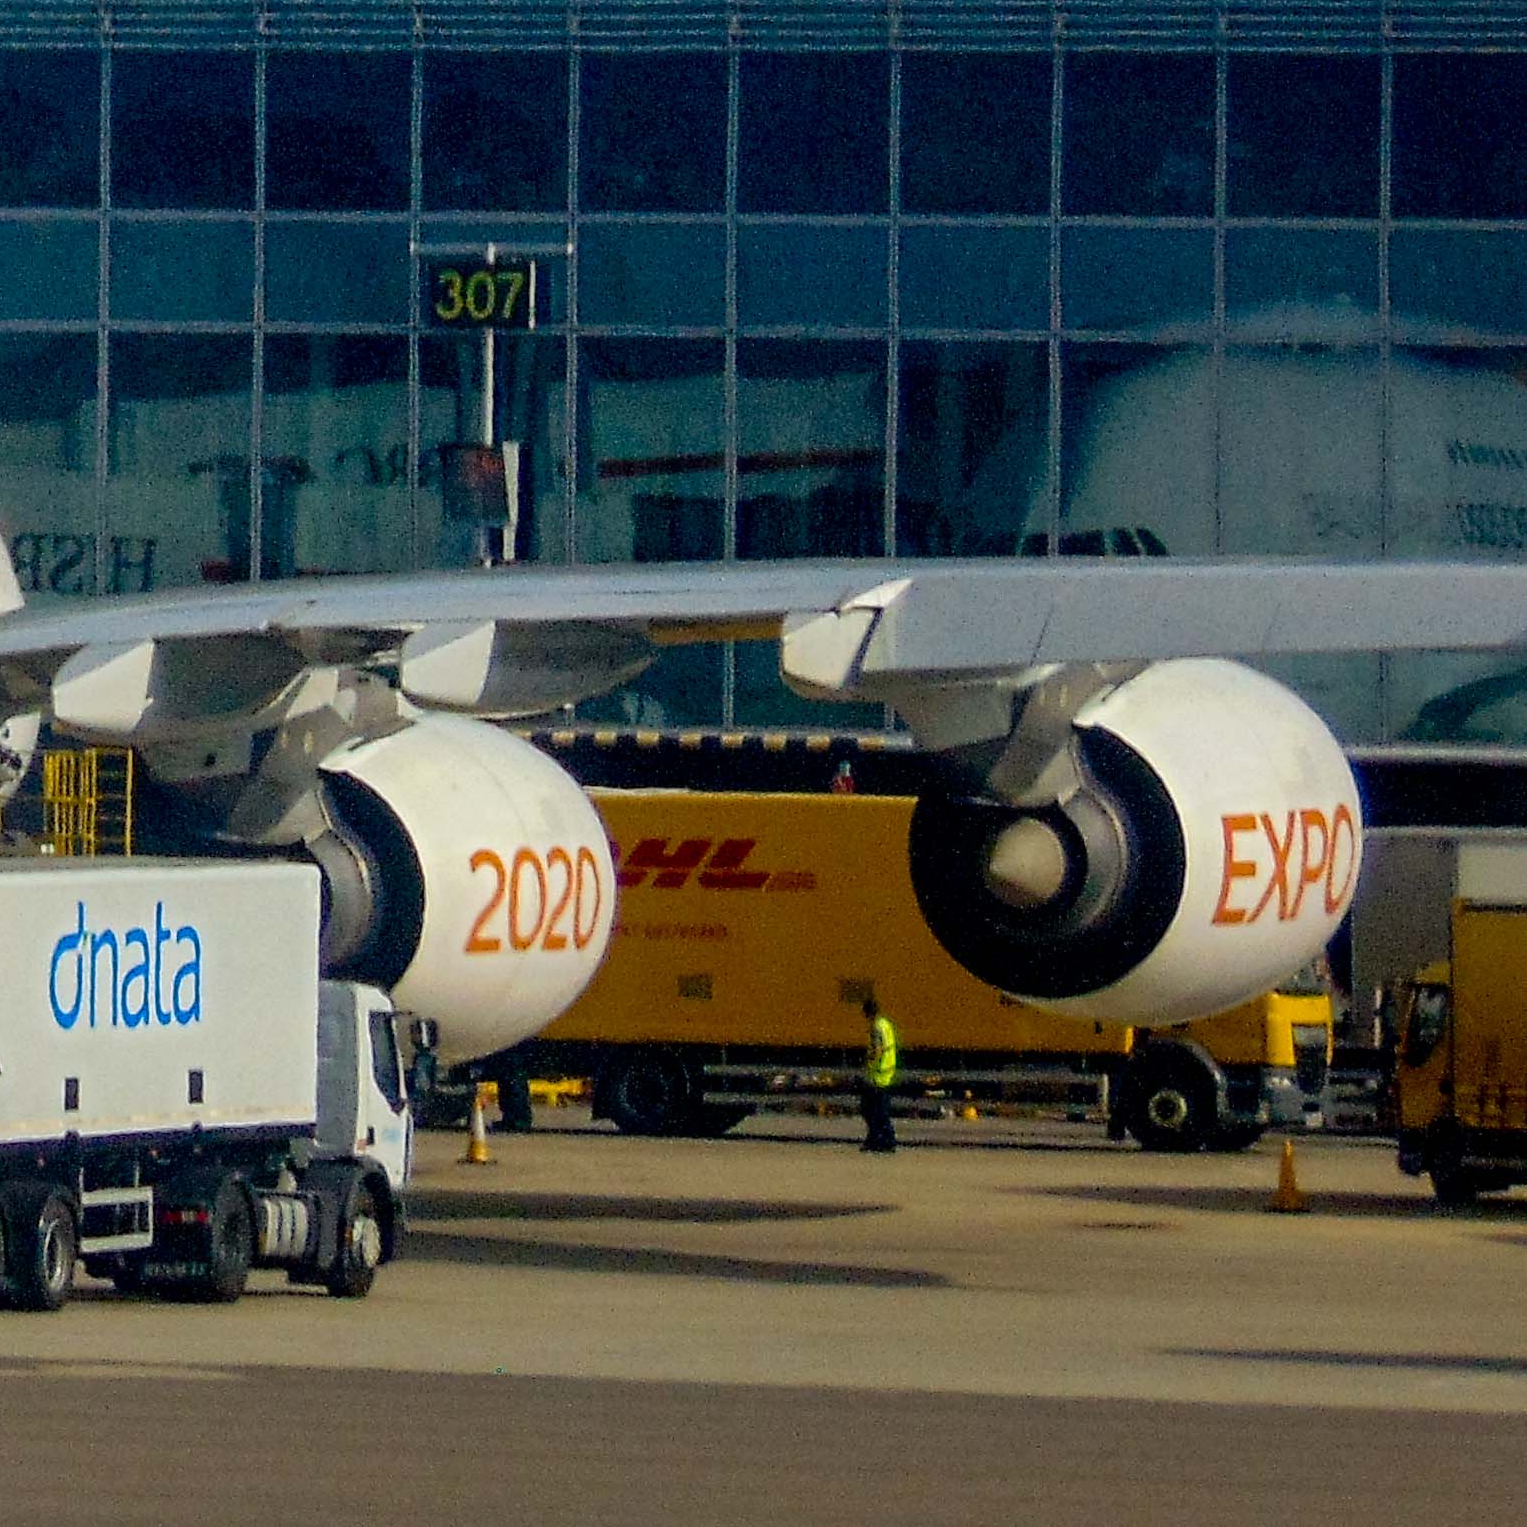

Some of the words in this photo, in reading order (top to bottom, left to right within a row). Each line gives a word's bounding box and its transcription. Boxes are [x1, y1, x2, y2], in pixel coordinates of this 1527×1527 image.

[435, 269, 524, 320] 307
[463, 846, 601, 954] 2020
[608, 838, 770, 889] HL
[1211, 802, 1355, 925] EXPO
[49, 900, 202, 1030] dnata
